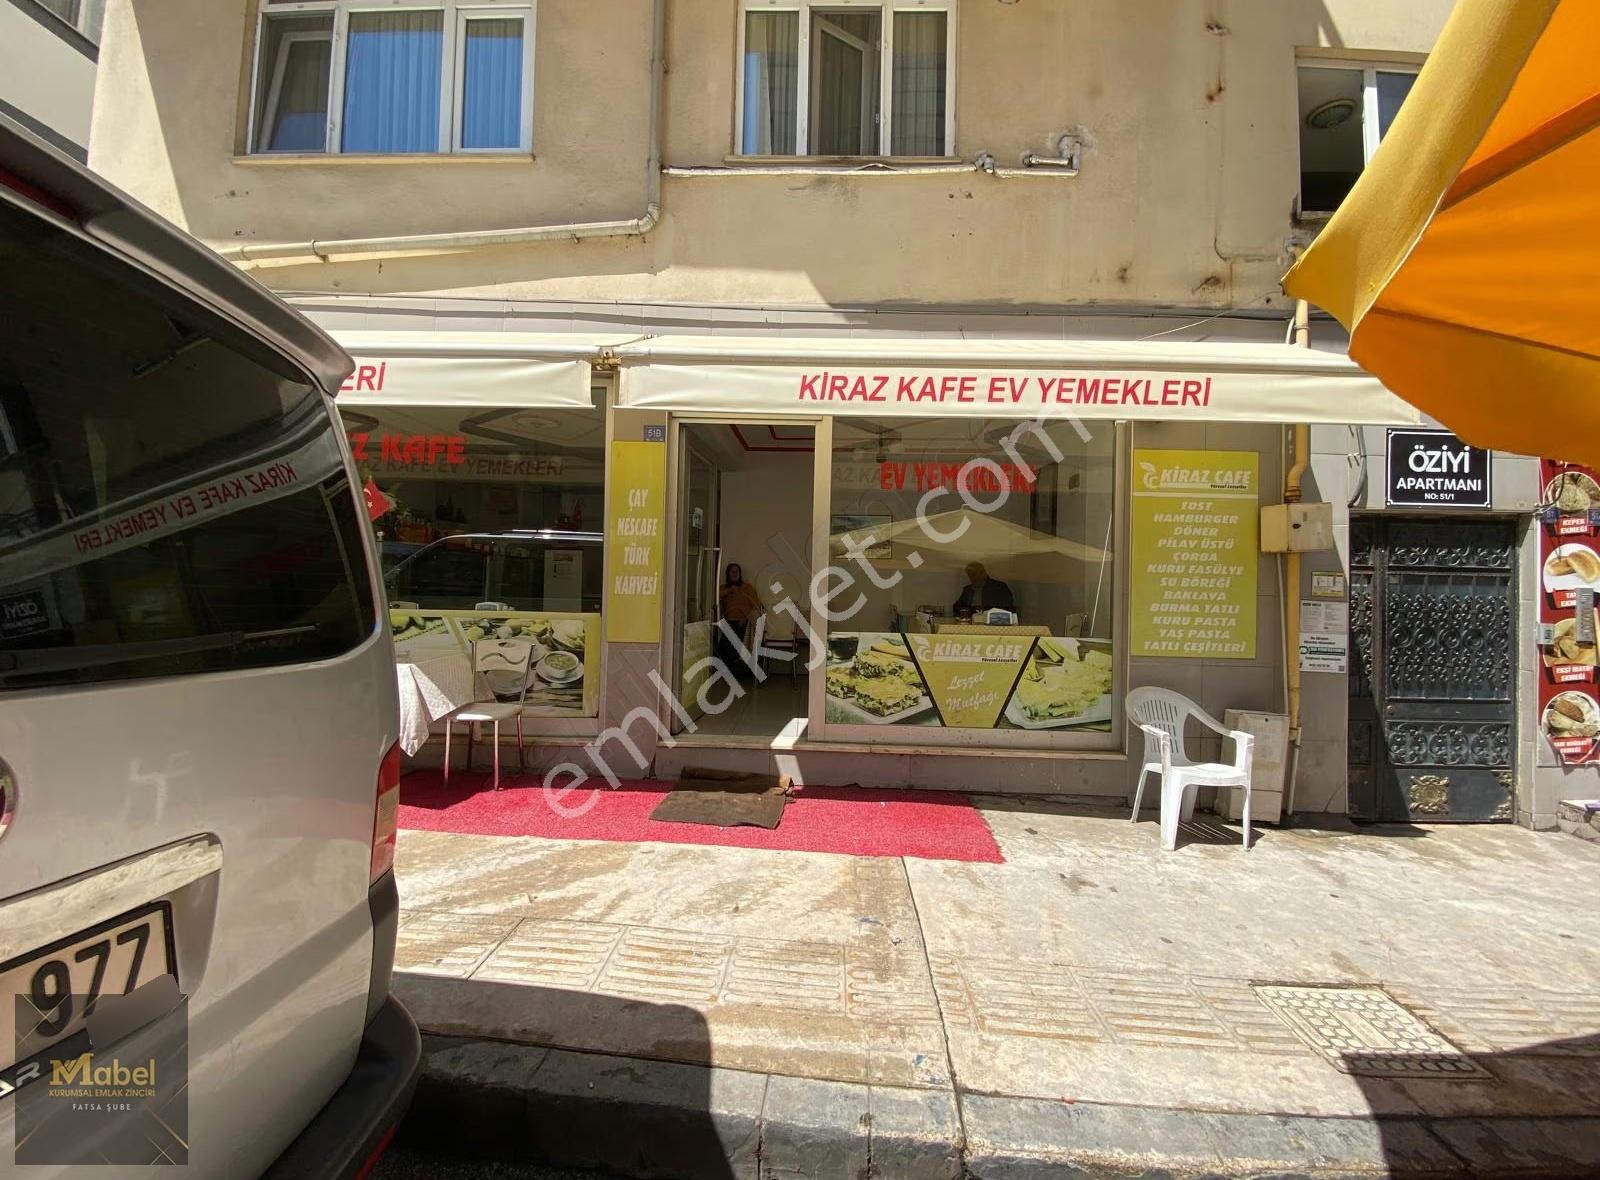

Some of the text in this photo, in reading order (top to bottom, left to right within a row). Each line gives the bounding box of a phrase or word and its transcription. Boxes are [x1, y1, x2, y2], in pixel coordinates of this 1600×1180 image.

[798, 371, 1212, 407] KİRAZ KAFE EV YEMEKLERİ
[381, 431, 466, 465] KAFE
[1408, 444, 1470, 474] ÖZİYİ
[880, 462, 908, 491] EV
[1160, 465, 1252, 484] KİRAZ CAFE
[1396, 477, 1482, 491] APARTMANI
[628, 489, 649, 511] ÇAY
[1181, 502, 1213, 511] TOST
[1153, 513, 1240, 524] HAMBURGER
[617, 517, 658, 536] NESCAFE
[1173, 524, 1219, 536] DÖNER
[1200, 538, 1234, 549] ÜSTÜ
[623, 543, 650, 565] TÜRK
[1172, 551, 1217, 563] ÇORBA
[1146, 564, 1186, 573] KURU
[615, 572, 658, 596] KAHVESİ
[1160, 577, 1177, 587] SU
[1163, 590, 1226, 601] BAKLAVA
[1150, 603, 1240, 614] BURMA TATLI
[1152, 616, 1237, 627] KURU PASTA
[1160, 628, 1231, 640] YAŞ PASTA
[934, 640, 1023, 658] KİRAZ CAFE
[1144, 641, 1180, 651] TATLI
[31, 922, 151, 1038] 977
